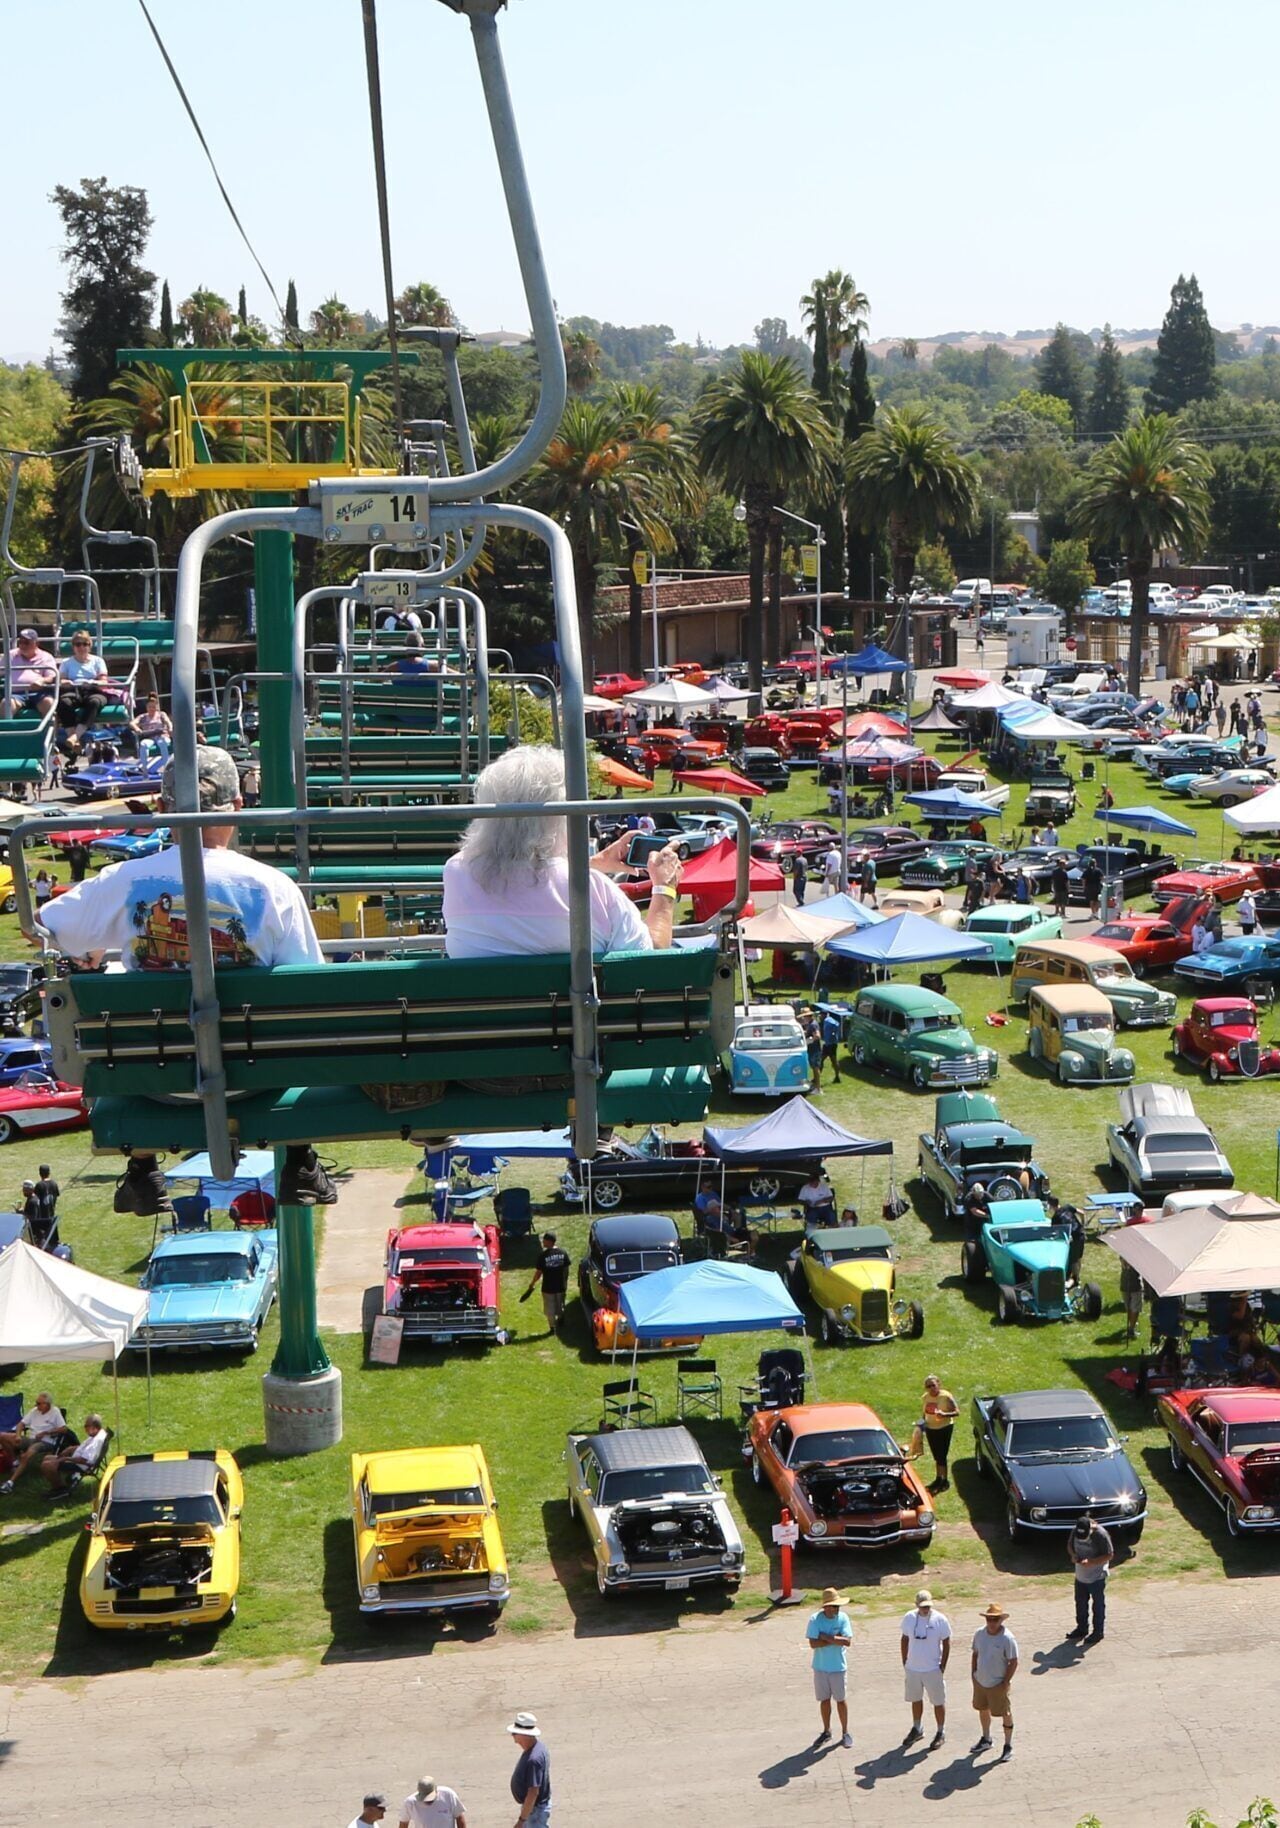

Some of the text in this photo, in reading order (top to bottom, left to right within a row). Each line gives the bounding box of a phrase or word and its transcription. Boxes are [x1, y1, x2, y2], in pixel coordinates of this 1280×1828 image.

[336, 502, 353, 520] SKY
[351, 498, 374, 518] TRAC
[390, 495, 416, 522] 14
[396, 582, 409, 596] 13
